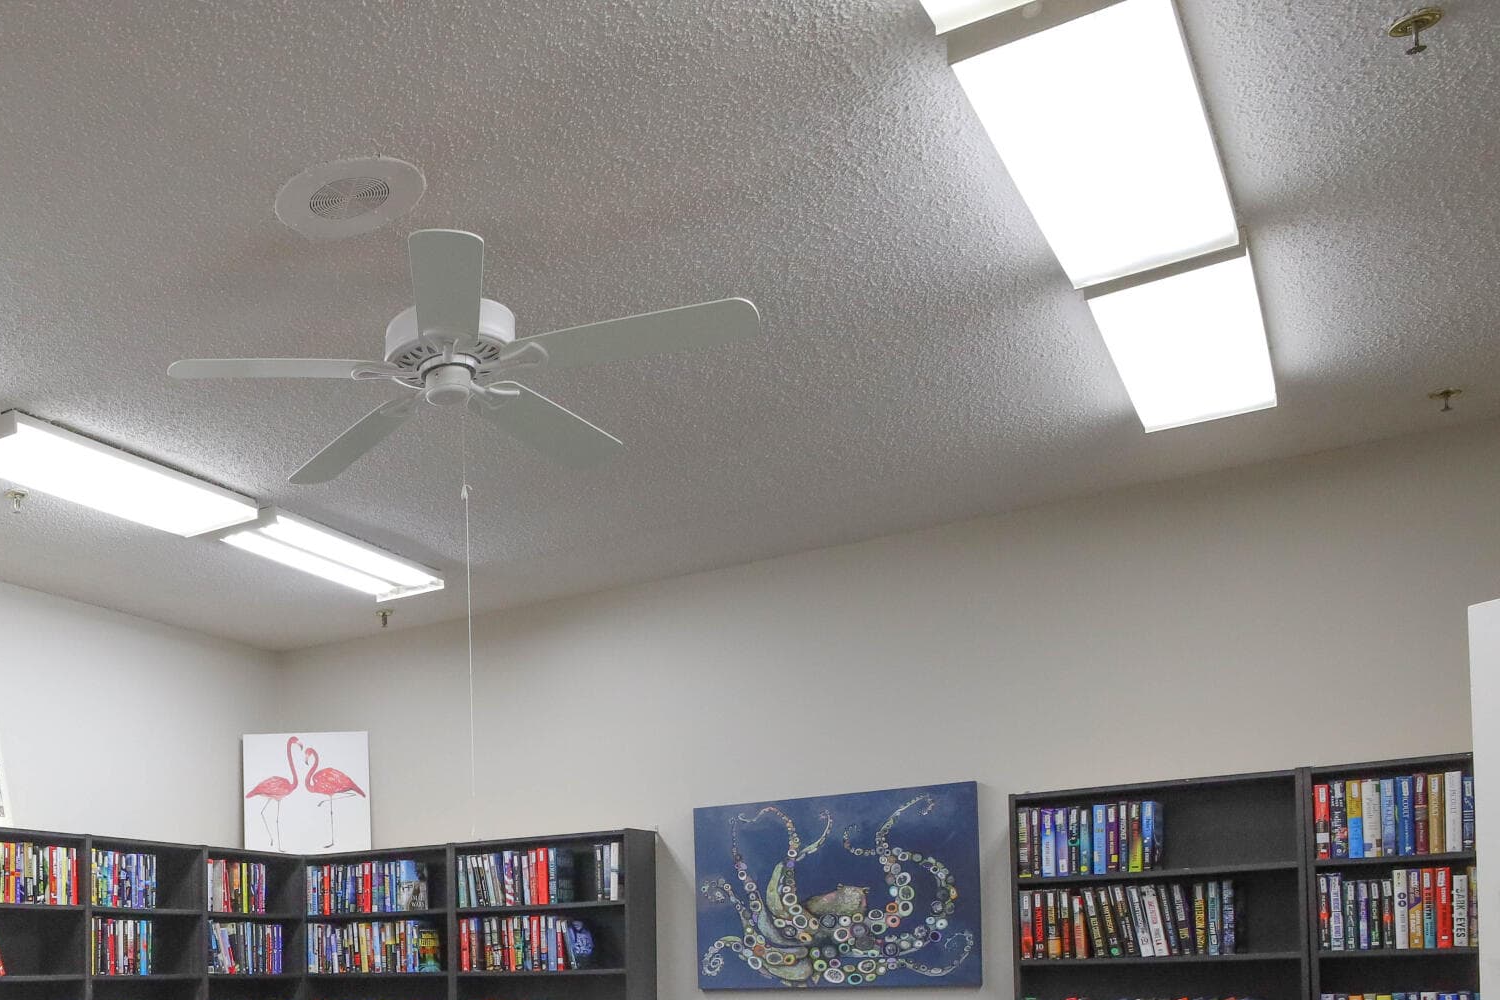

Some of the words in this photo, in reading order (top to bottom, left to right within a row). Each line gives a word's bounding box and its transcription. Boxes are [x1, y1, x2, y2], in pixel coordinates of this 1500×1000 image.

[1102, 906, 1114, 933] PATTERSON
[1195, 899, 1206, 929] PATTERSON
[1456, 917, 1466, 938] EYES
